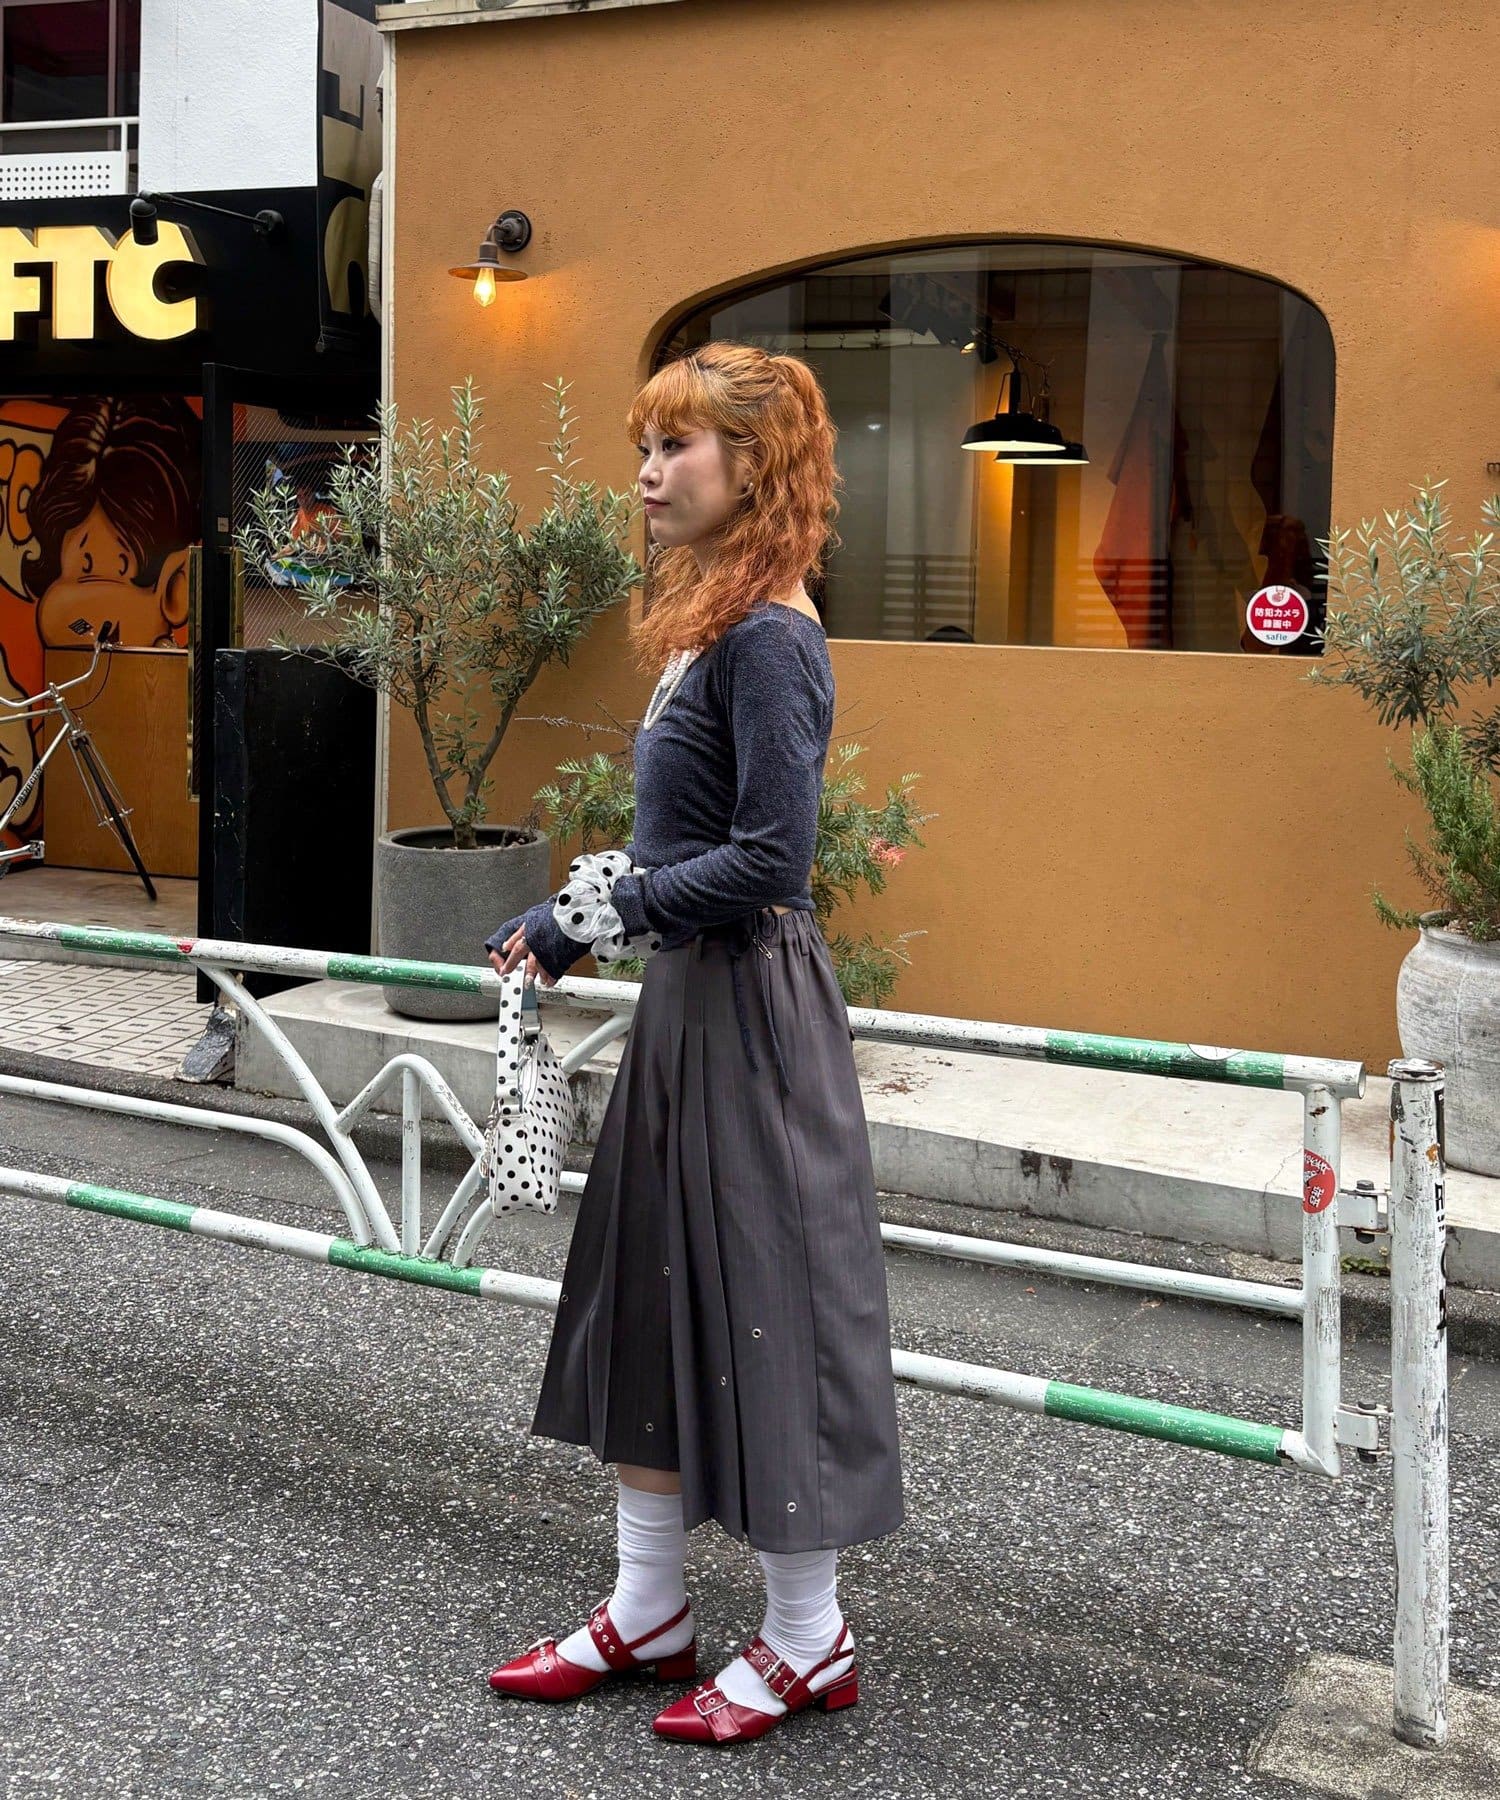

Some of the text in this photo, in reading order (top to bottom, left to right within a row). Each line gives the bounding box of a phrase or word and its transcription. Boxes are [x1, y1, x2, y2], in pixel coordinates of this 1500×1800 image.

[0, 219, 203, 341] FTC
[1254, 607, 1300, 617] 防犯カメラ
[1262, 618, 1292, 629] 録画中
